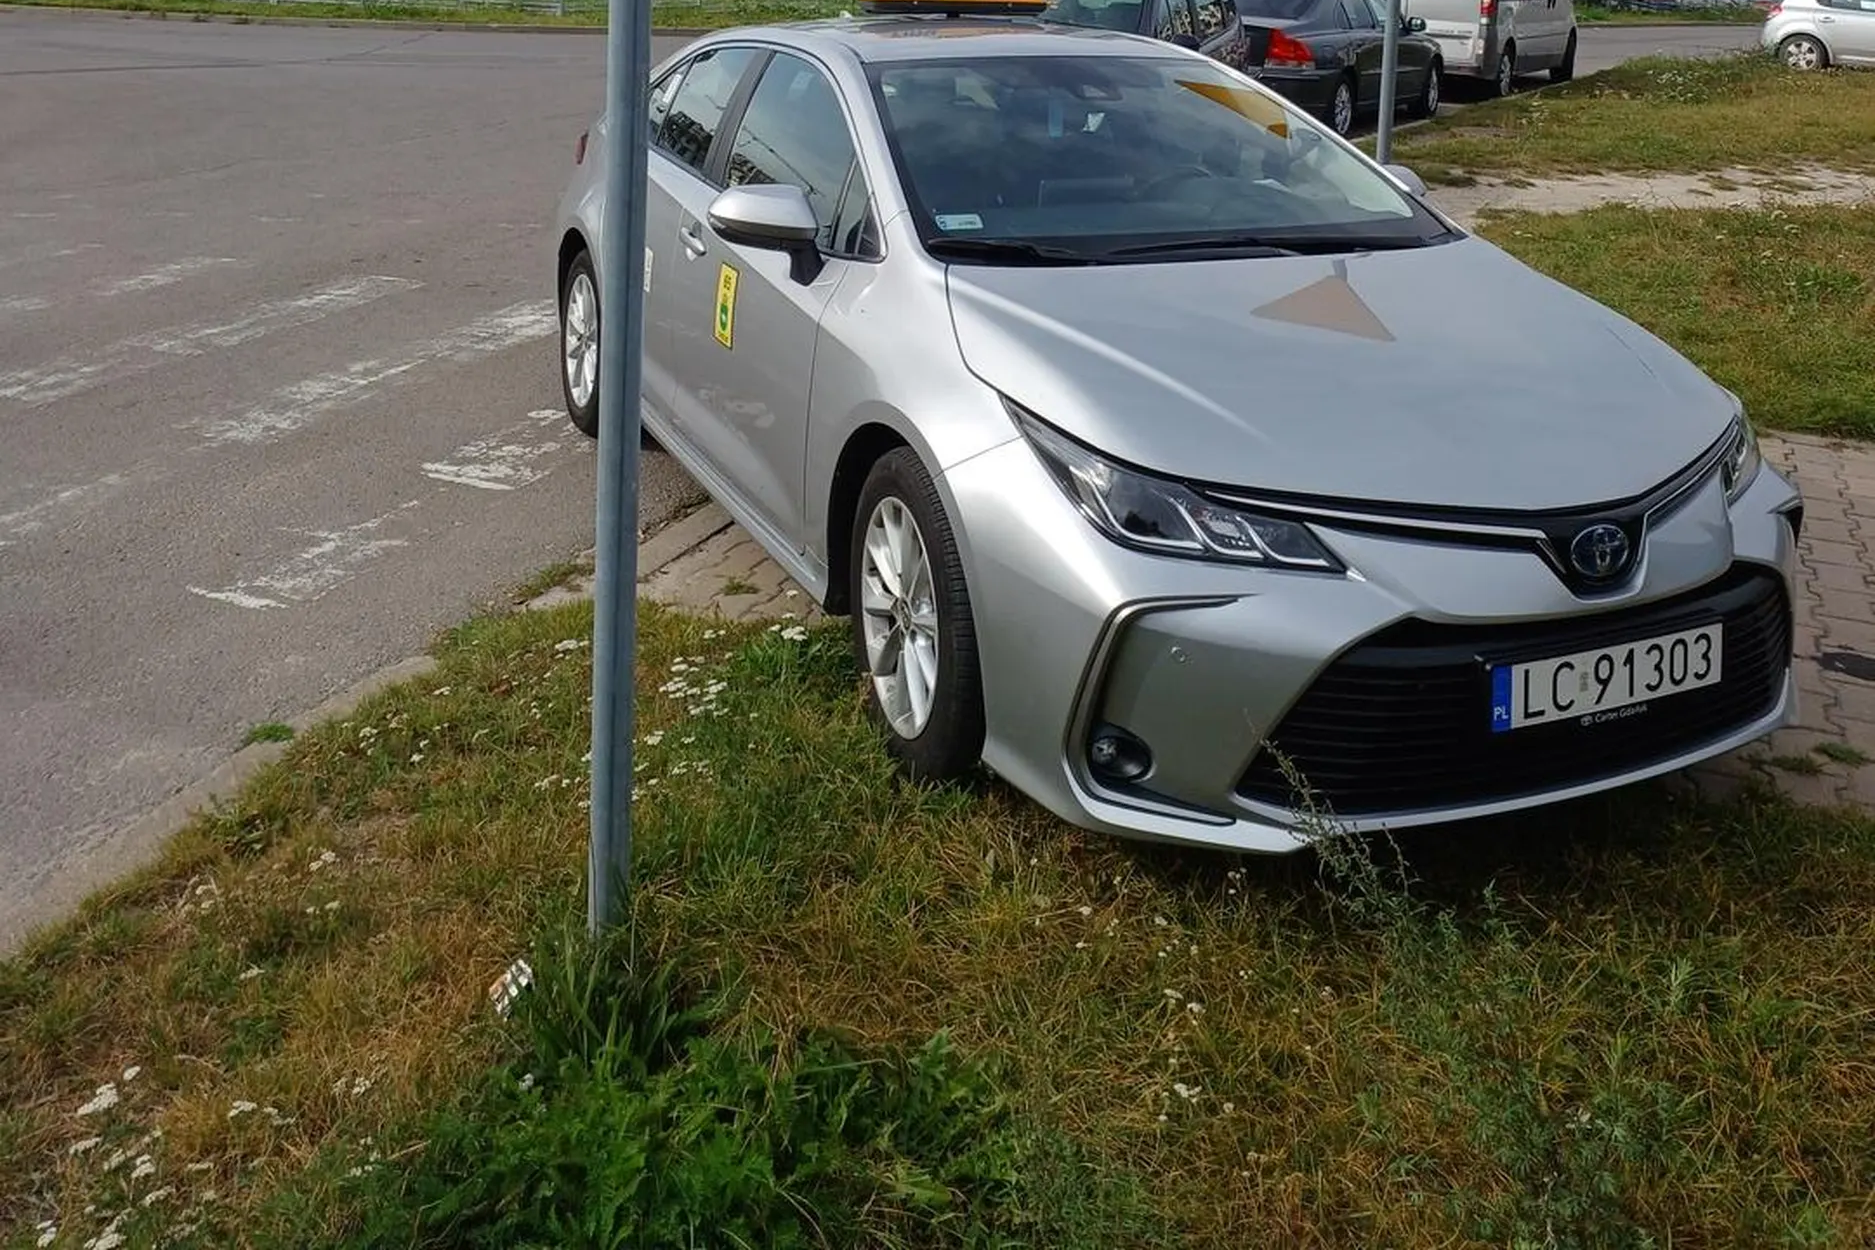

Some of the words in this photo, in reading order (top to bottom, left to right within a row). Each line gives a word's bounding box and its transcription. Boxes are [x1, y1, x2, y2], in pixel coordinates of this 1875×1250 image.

[1523, 661, 1576, 719] LC
[1594, 632, 1713, 706] 91303
[1493, 705, 1510, 721] PL
